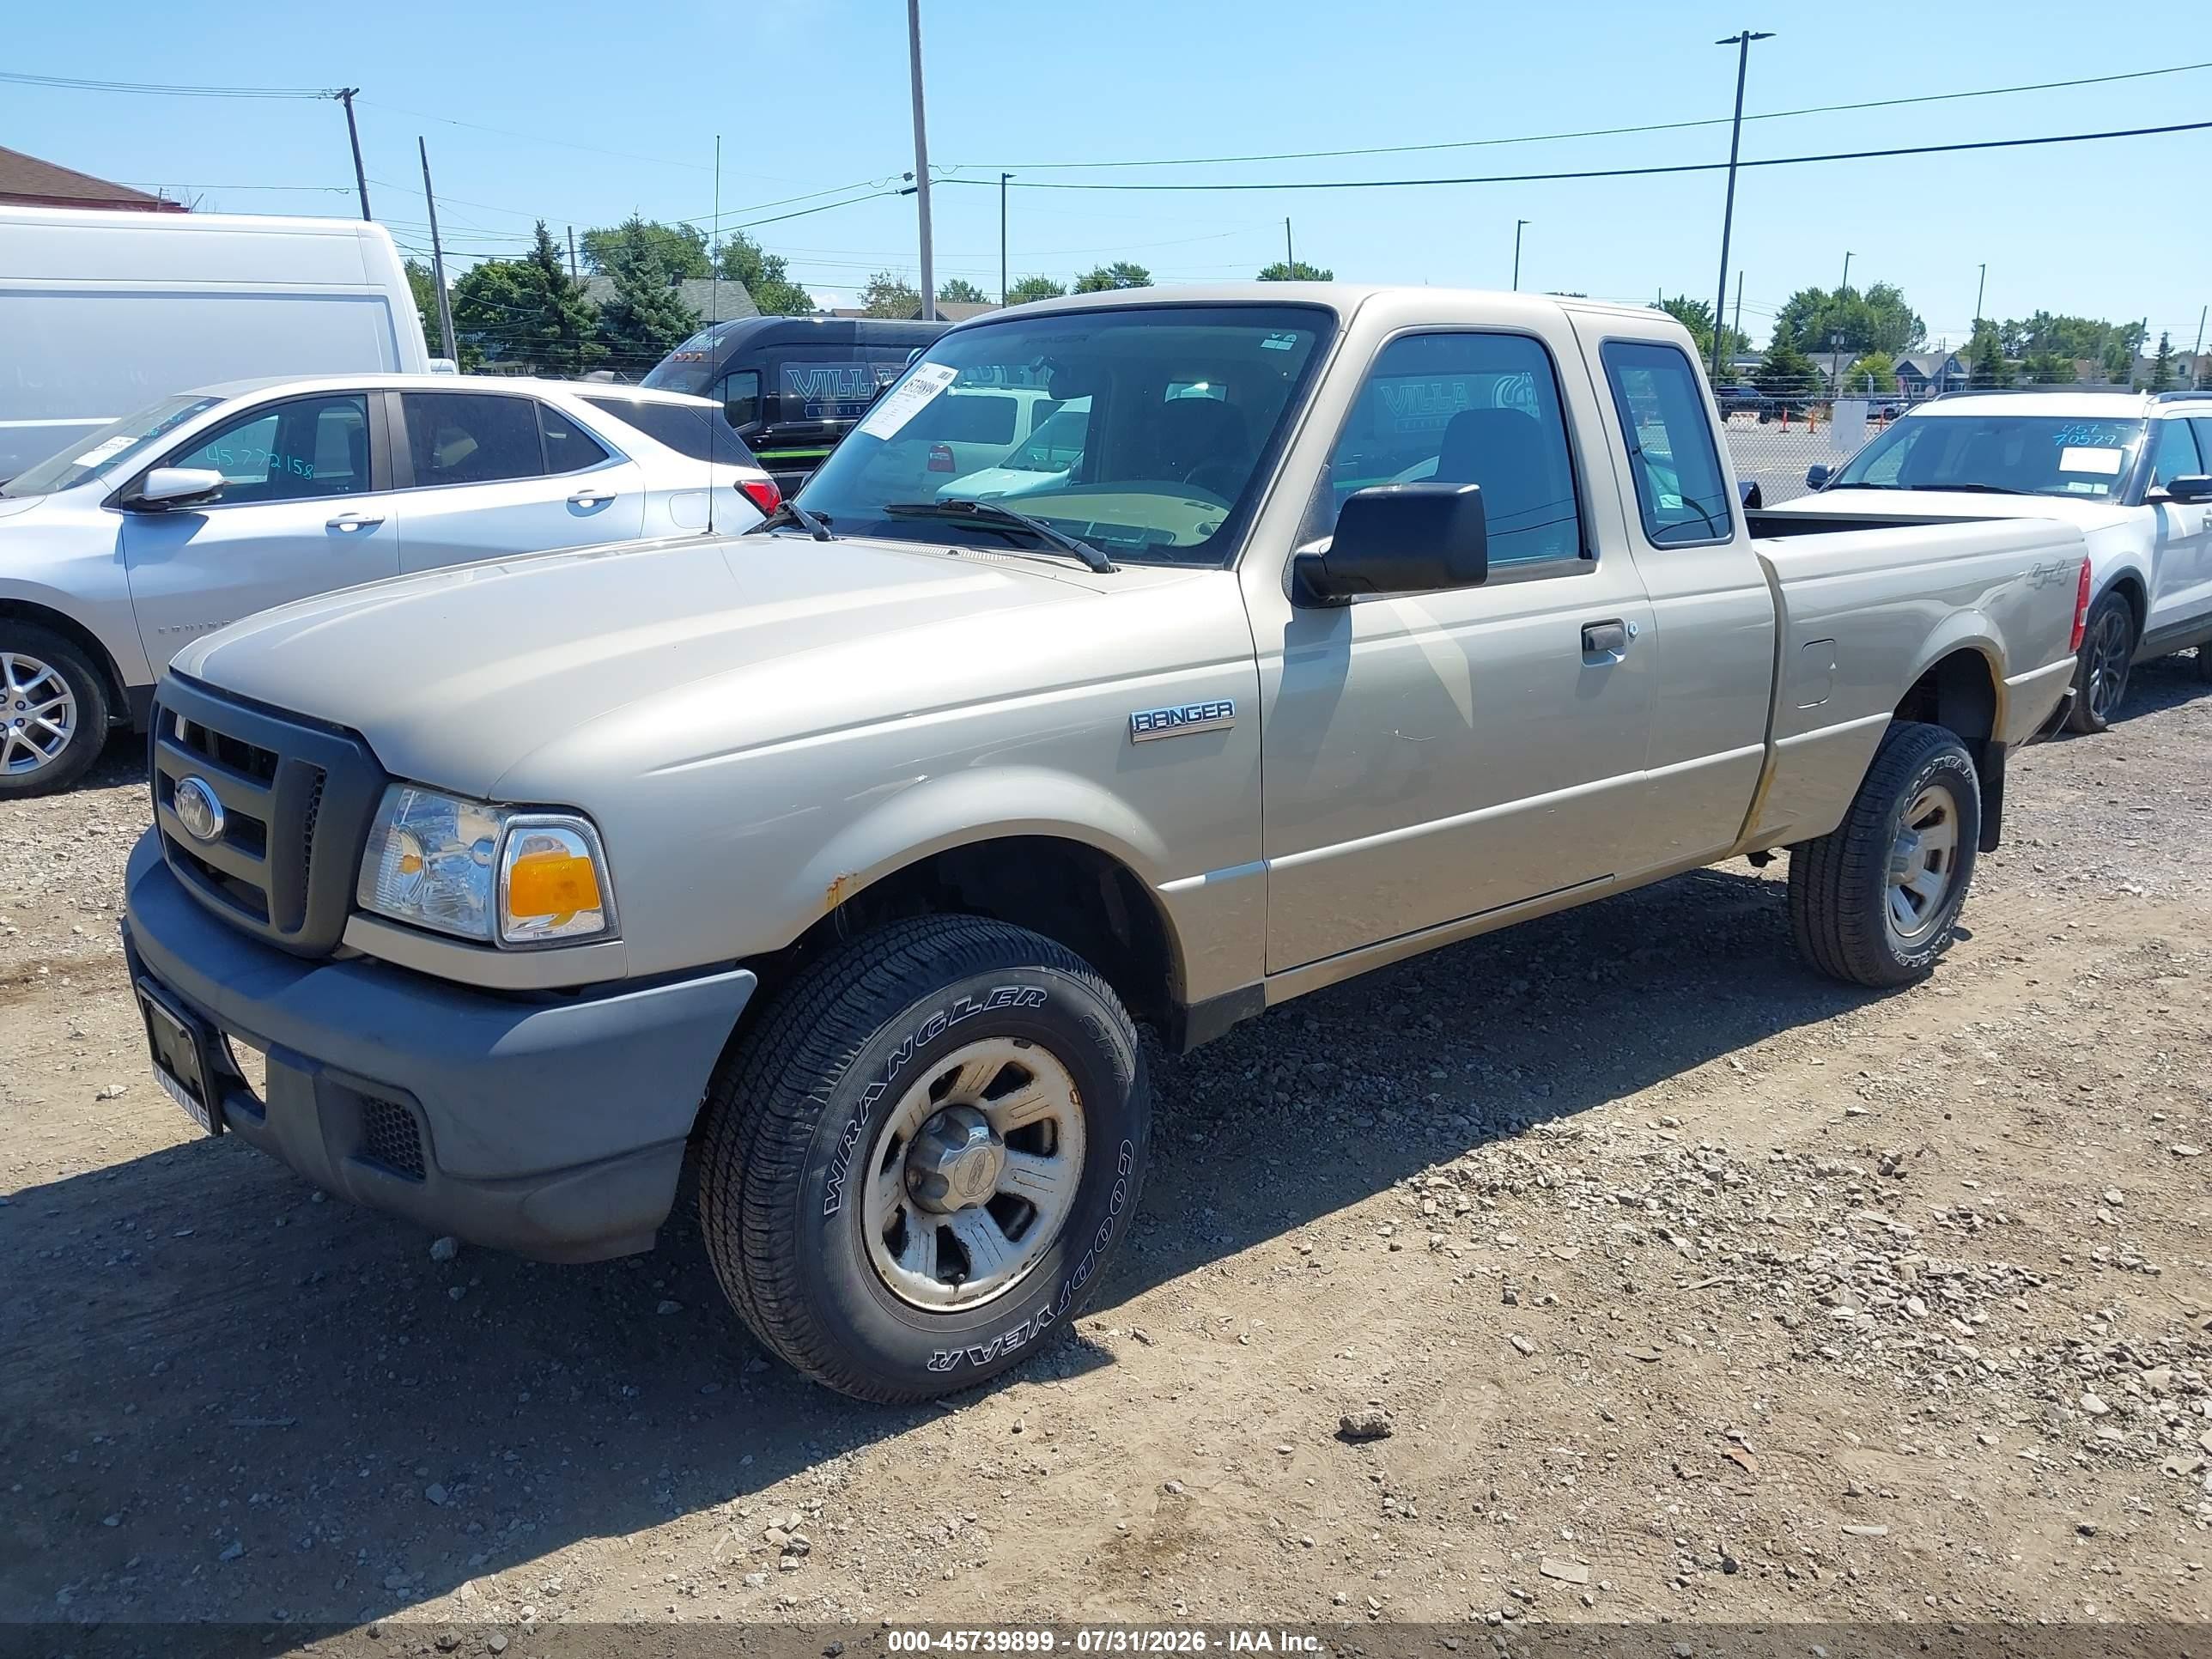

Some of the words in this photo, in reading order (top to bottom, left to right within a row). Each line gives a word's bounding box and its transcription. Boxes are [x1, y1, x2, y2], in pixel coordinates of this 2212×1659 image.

[1381, 383, 1469, 417] VILLA
[2061, 424, 2100, 434] 457
[205, 446, 315, 480] 45772158
[1133, 701, 1234, 732] RANGER
[177, 787, 203, 828] Ford
[824, 985, 1048, 1216] WRANGLER
[927, 1139, 1134, 1371] GOODYEAR
